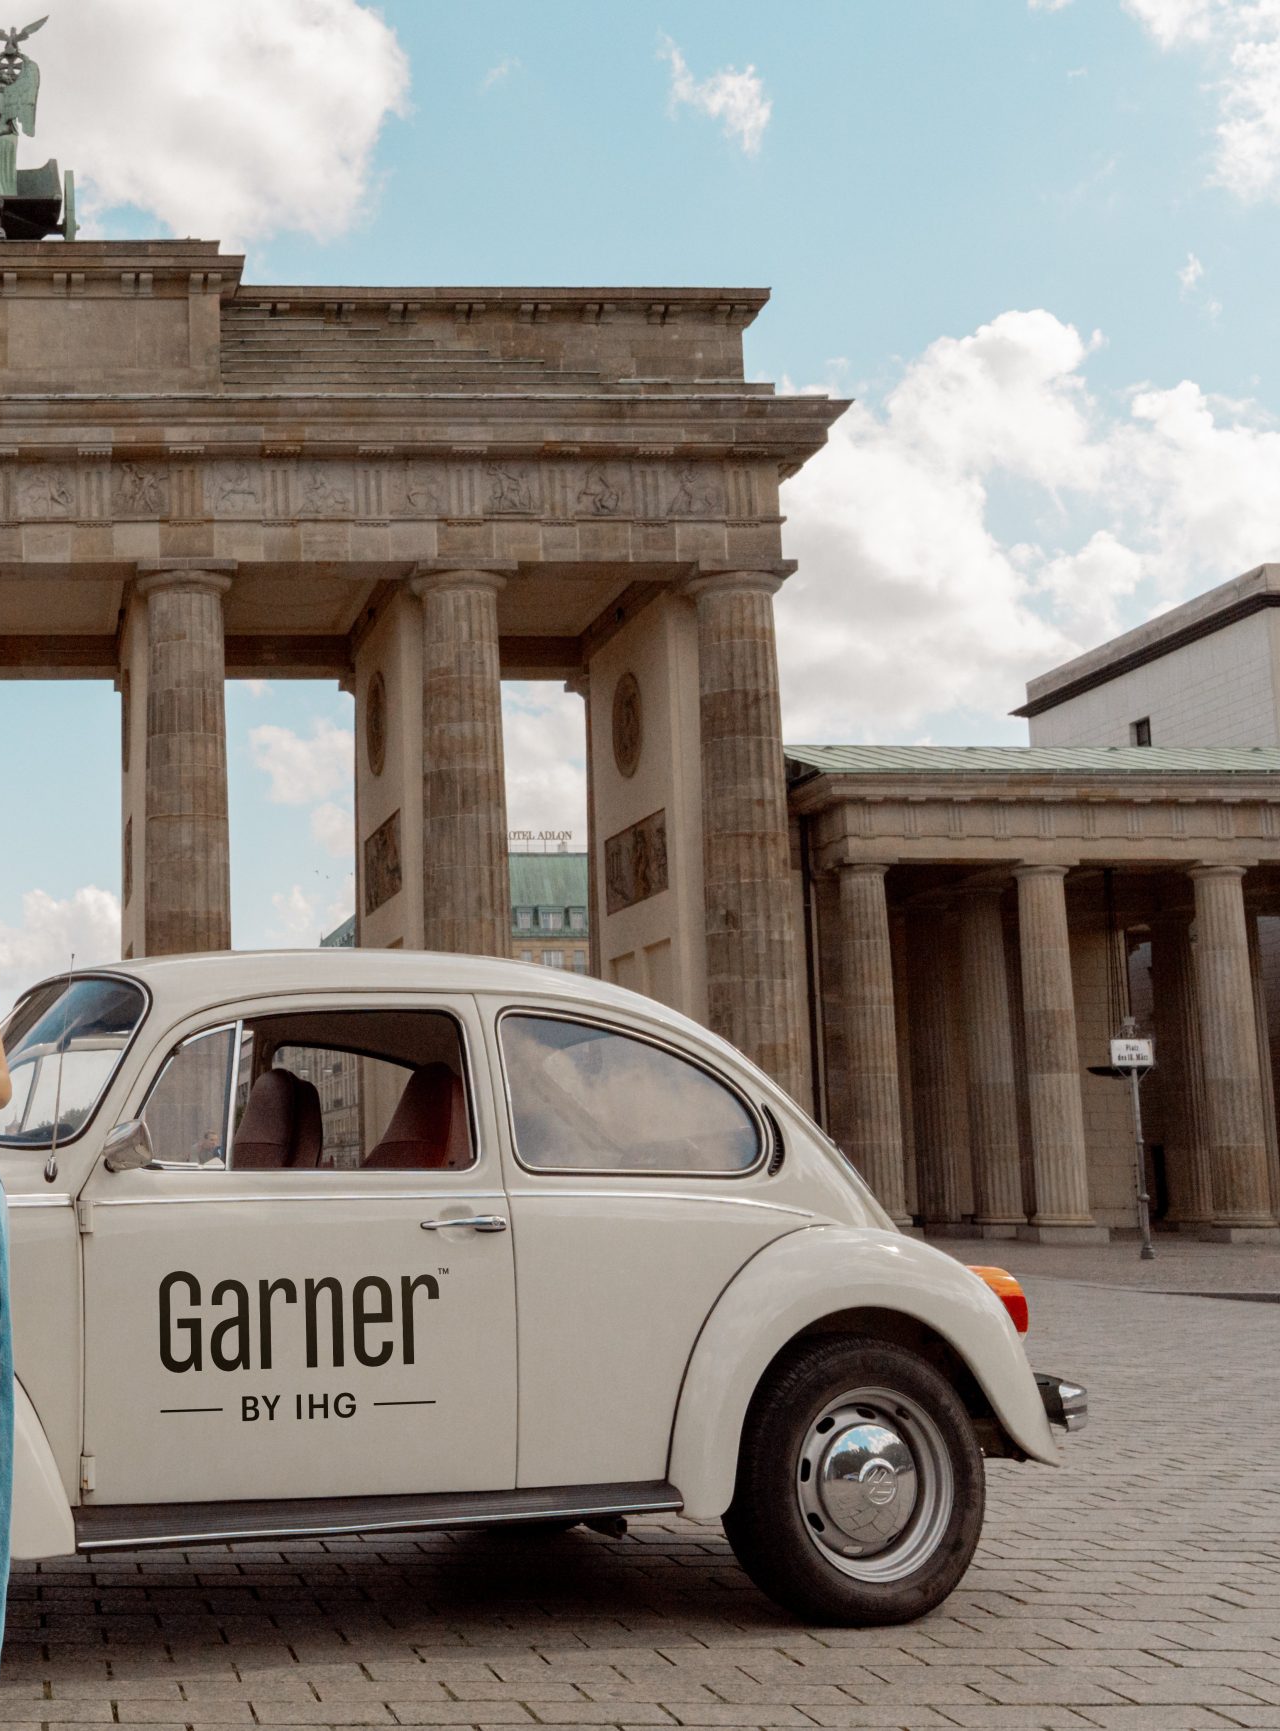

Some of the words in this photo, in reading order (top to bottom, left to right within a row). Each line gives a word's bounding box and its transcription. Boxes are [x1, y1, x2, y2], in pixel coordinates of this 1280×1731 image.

[507, 830, 535, 841] OTEL
[537, 830, 573, 841] ADLON
[241, 1394, 281, 1421] BY
[296, 1392, 357, 1419] IHG
